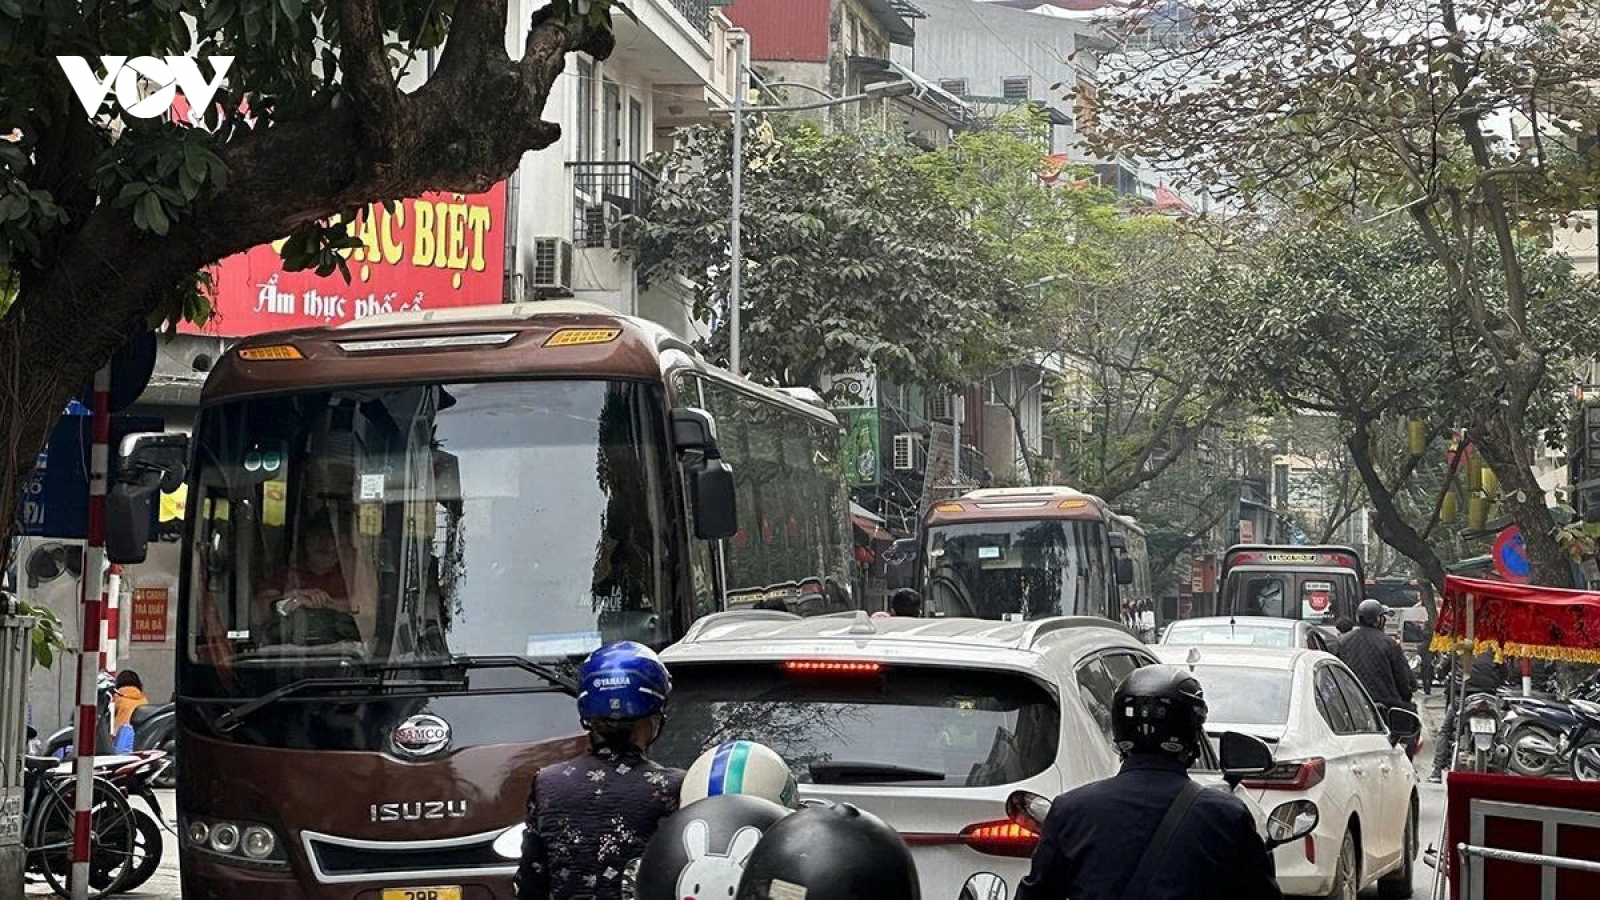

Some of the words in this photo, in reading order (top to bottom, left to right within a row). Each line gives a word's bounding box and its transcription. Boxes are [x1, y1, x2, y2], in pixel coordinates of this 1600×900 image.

[411, 192, 491, 289] BIỆT
[253, 273, 296, 315] Ẩm
[303, 289, 346, 323] thực
[354, 291, 397, 320] phố
[395, 728, 445, 742] SAMCO
[370, 800, 467, 822] ISUZU
